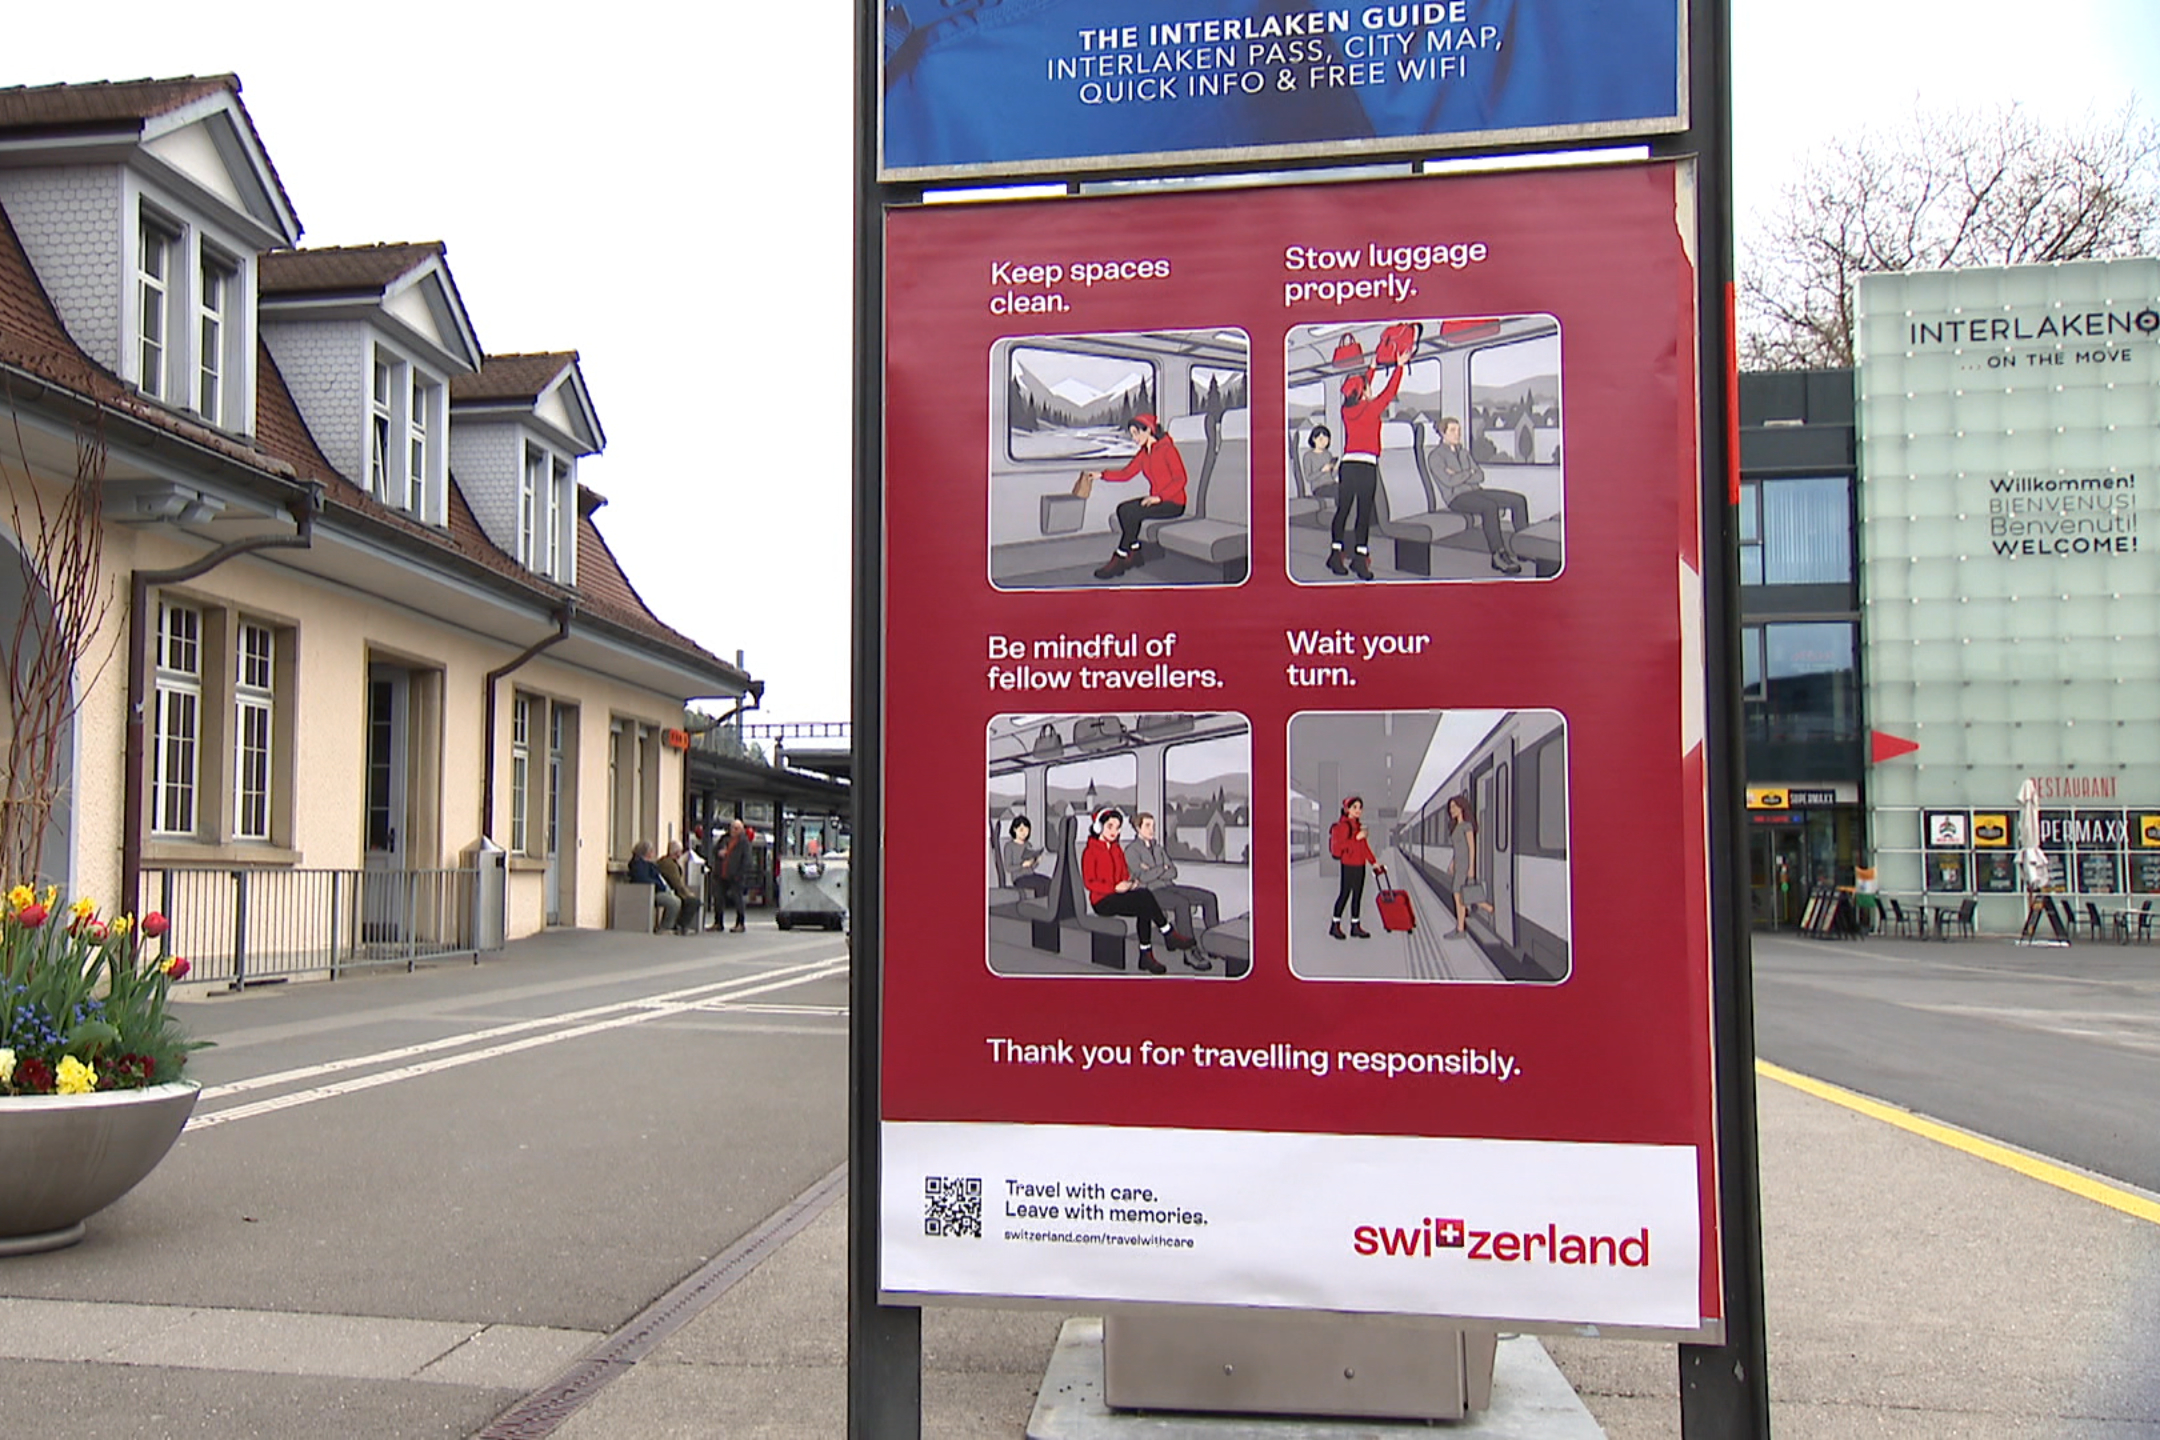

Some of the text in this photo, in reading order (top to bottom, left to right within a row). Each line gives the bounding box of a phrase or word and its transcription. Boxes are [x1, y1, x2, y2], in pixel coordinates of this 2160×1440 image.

[1079, 0, 1467, 51] THE INTERLAKEN GUIDE
[1047, 25, 1503, 81] INTERLAKEN PASS, CITY MAP,
[1079, 57, 1467, 104] QUICK INFO & FREE WIFI
[1285, 242, 1487, 271] Stow luggage
[991, 258, 1171, 288] Keep spaces
[990, 290, 1071, 314] clean.
[1285, 273, 1418, 307] properly.
[2026, 352, 2064, 367] THE
[2075, 348, 2132, 364] MOVE
[1990, 473, 2135, 494] Willkommen!
[1990, 494, 2137, 515] BIENVENUS!
[1990, 513, 2138, 537] Benvenuti!
[1992, 536, 2138, 557] WELCOME!
[988, 632, 1176, 659] Be mindful of
[1286, 630, 1430, 660] Wait your
[987, 664, 1225, 690] fellow travellers.
[1286, 664, 1357, 686] turn.
[2040, 819, 2128, 843] PERMAXX
[986, 1038, 1522, 1081] Thank you for travelling responsibly.
[1005, 1179, 1159, 1203] Travel with care.
[1005, 1200, 1208, 1226] Leave with memories.
[1004, 1230, 1194, 1248] switzerland.com/travelwithcare
